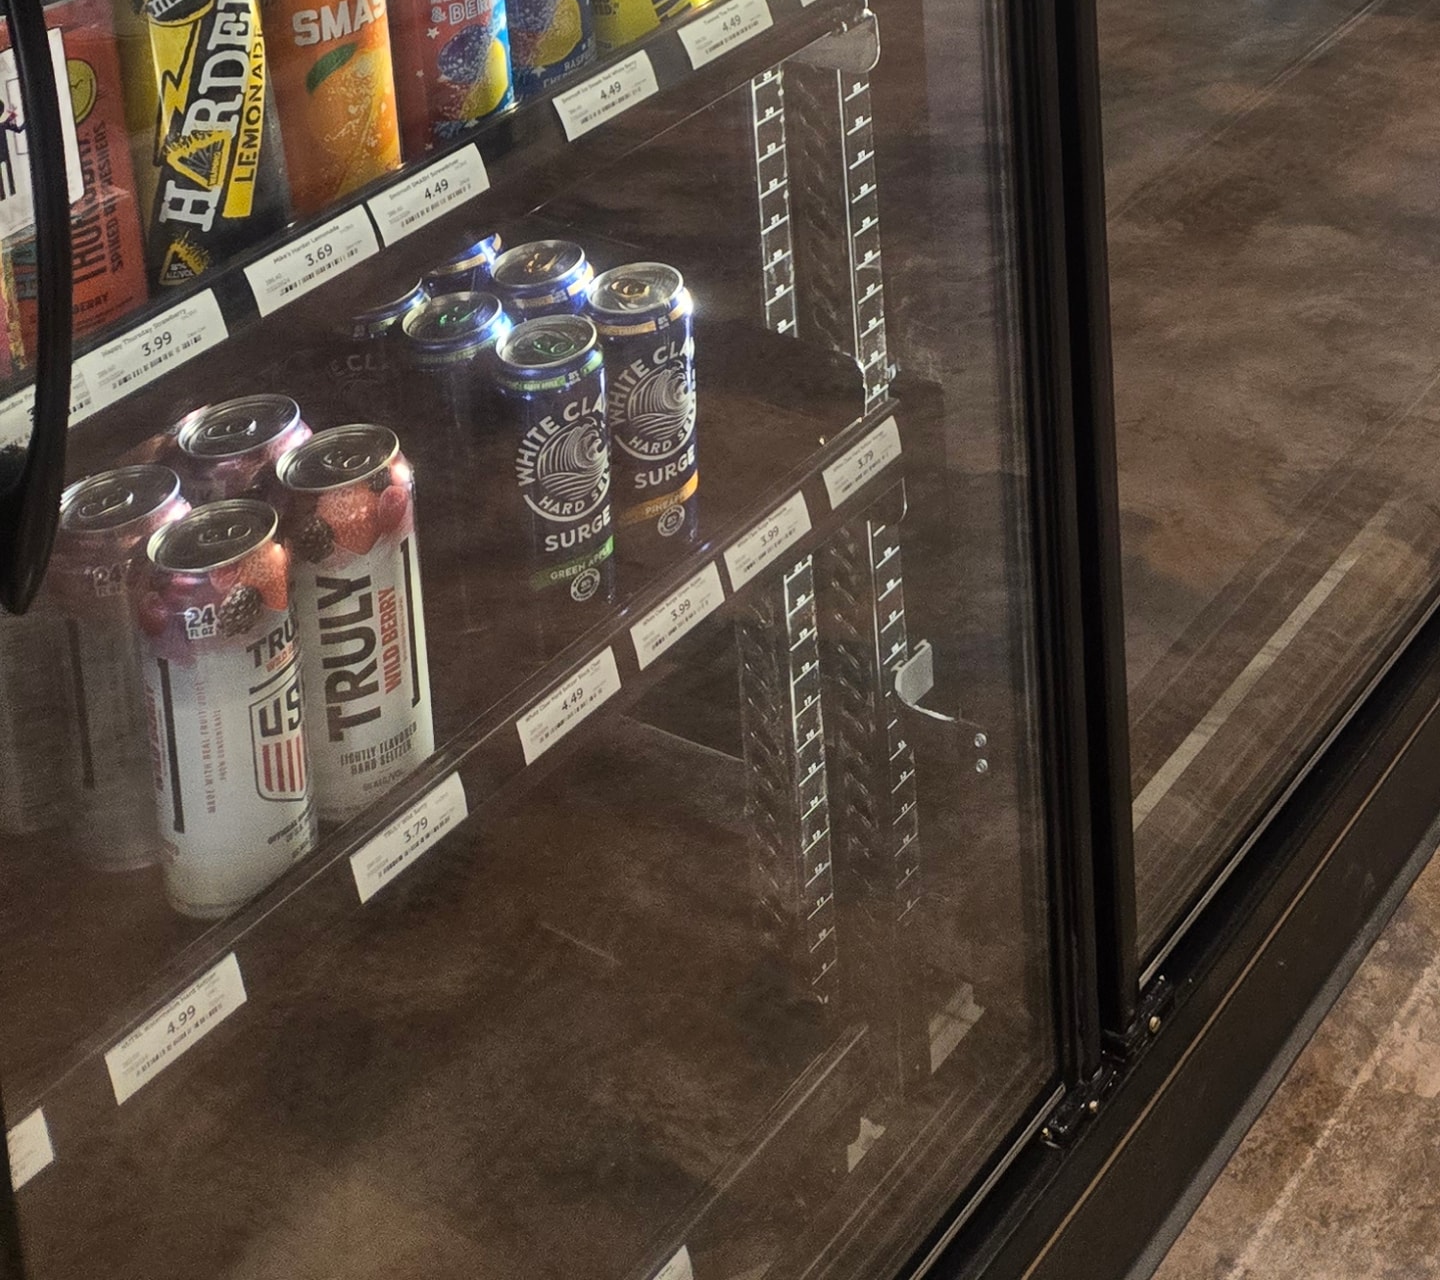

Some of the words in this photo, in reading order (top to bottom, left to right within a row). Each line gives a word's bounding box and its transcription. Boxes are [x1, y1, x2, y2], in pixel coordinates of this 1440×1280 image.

[431, 7, 447, 23] &
[722, 15, 741, 32] 4.49
[600, 81, 622, 99] 4.49
[424, 178, 449, 201] 4.49
[304, 244, 333, 267] 3.69
[141, 331, 172, 357] 3.99
[608, 359, 650, 426] WHITE
[515, 416, 560, 487] WHITE
[628, 436, 673, 455] HARD
[634, 444, 696, 489] SURGE
[857, 450, 874, 469] 3.79
[538, 496, 585, 515] HARD
[545, 504, 611, 552] SURGE
[760, 526, 779, 547] 3.99
[550, 565, 585, 580] GREEN
[187, 606, 215, 628] 24
[378, 586, 399, 644] BERRY
[671, 600, 691, 621] 3.99
[202, 625, 213, 636] OZ
[316, 575, 381, 742] TRULY
[379, 645, 401, 695] WILD
[561, 688, 584, 711] 4.49
[341, 744, 377, 766] LIGHTLY
[350, 756, 377, 776] HARD
[403, 817, 428, 843] 3.79
[167, 1005, 196, 1035] 4.99
